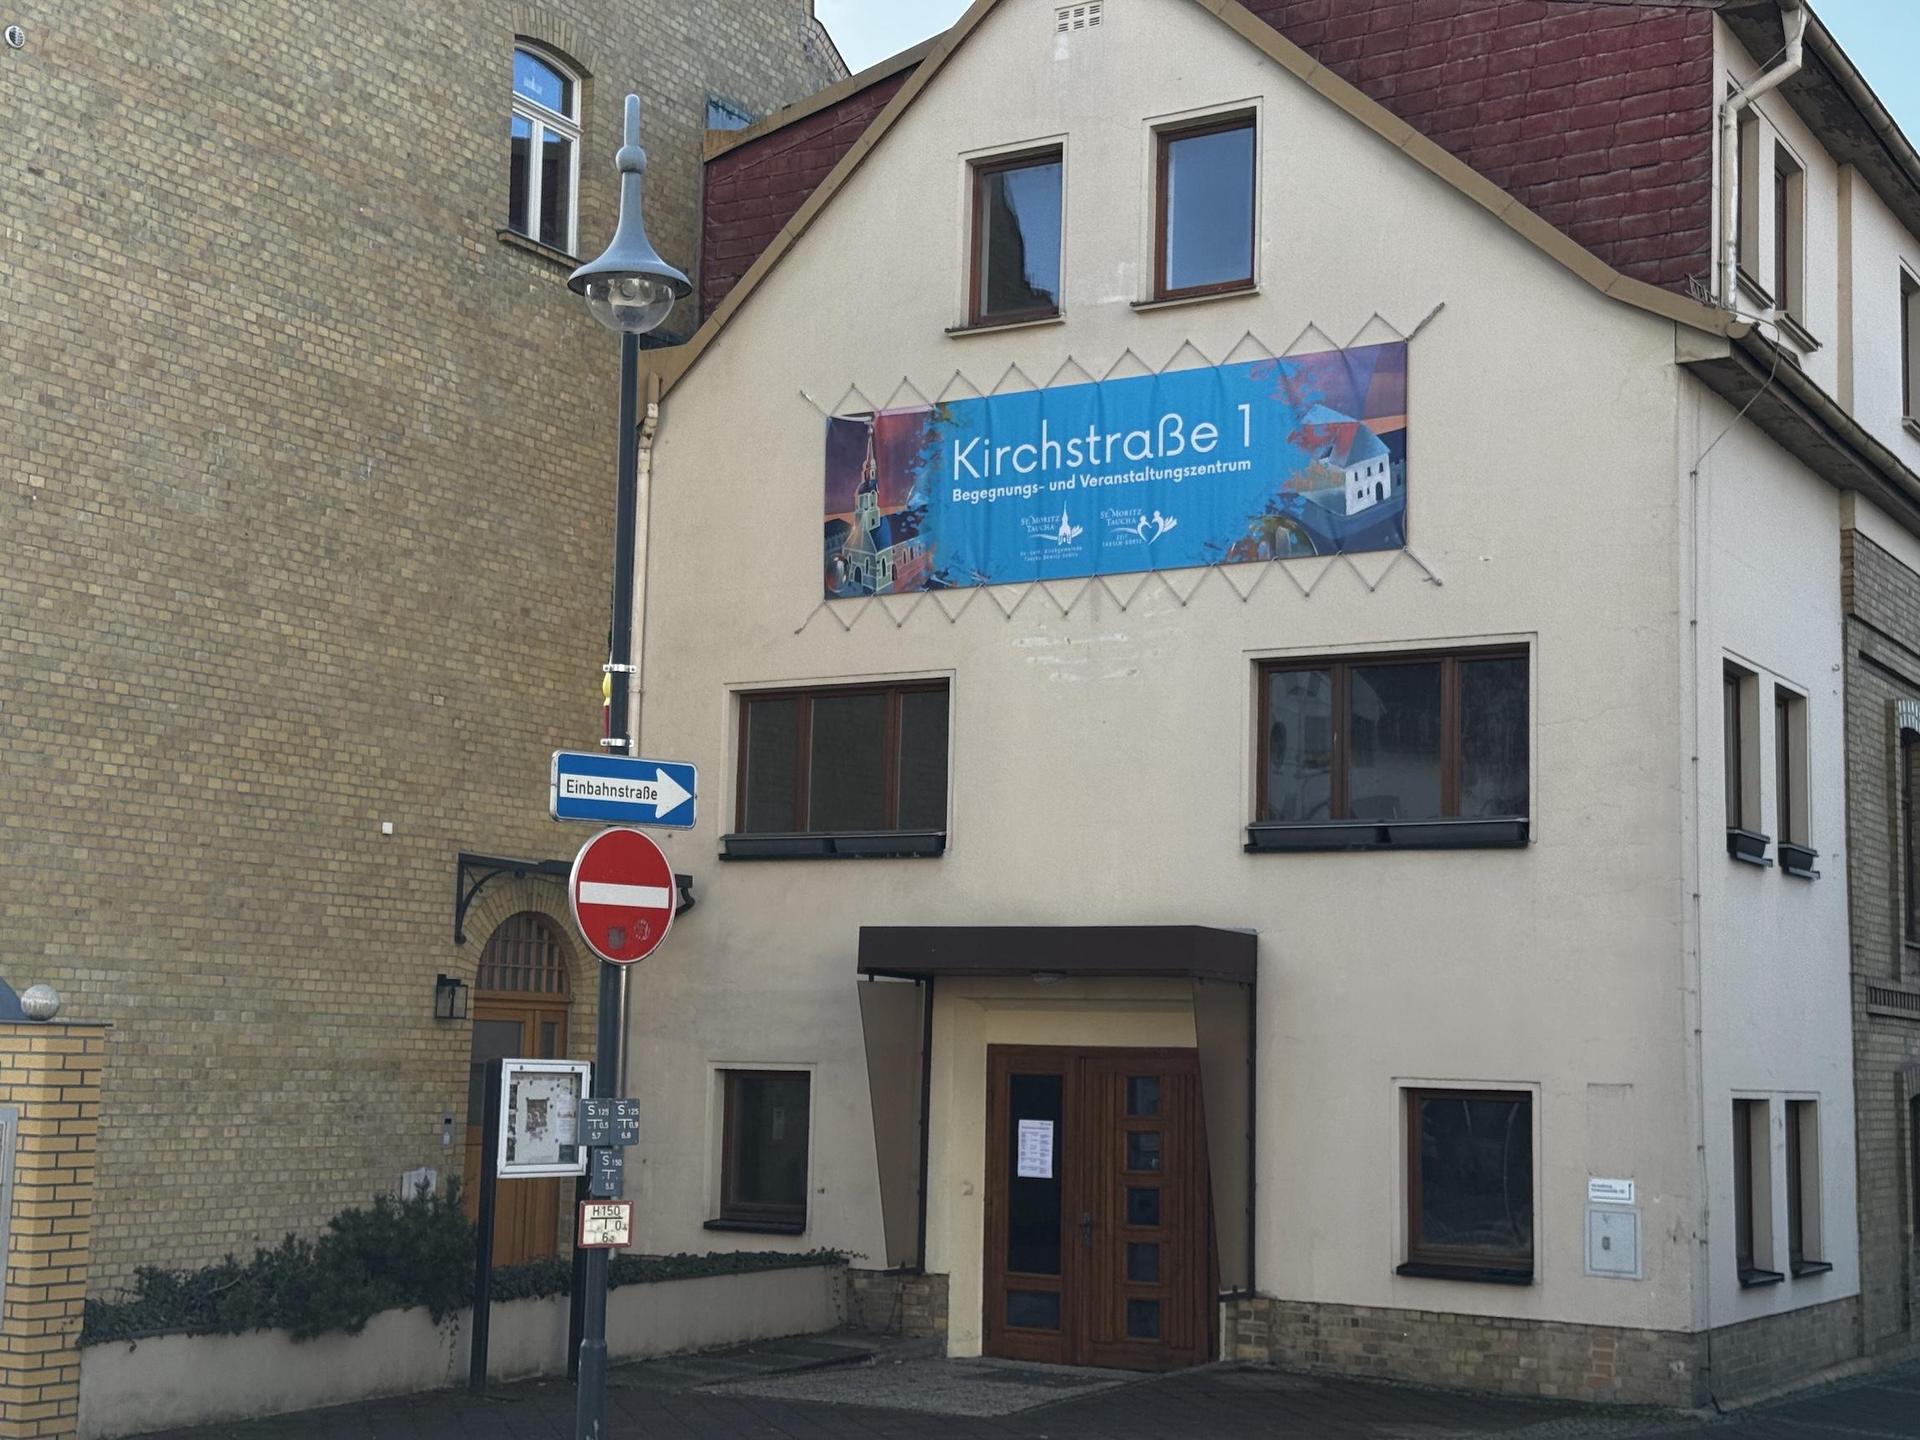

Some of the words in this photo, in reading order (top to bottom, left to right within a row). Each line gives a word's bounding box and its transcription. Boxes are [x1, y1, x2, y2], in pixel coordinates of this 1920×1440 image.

[954, 412, 1218, 481] Kirchstraße
[1238, 403, 1251, 448] 1
[953, 483, 1045, 504] Begegnungs-
[1049, 475, 1076, 492] und
[1080, 459, 1251, 488] Veranstaltungszentrum
[566, 779, 658, 800] Einbahnstraße
[588, 1104, 596, 1116] S
[617, 1104, 626, 1116] S
[602, 1155, 610, 1166] S
